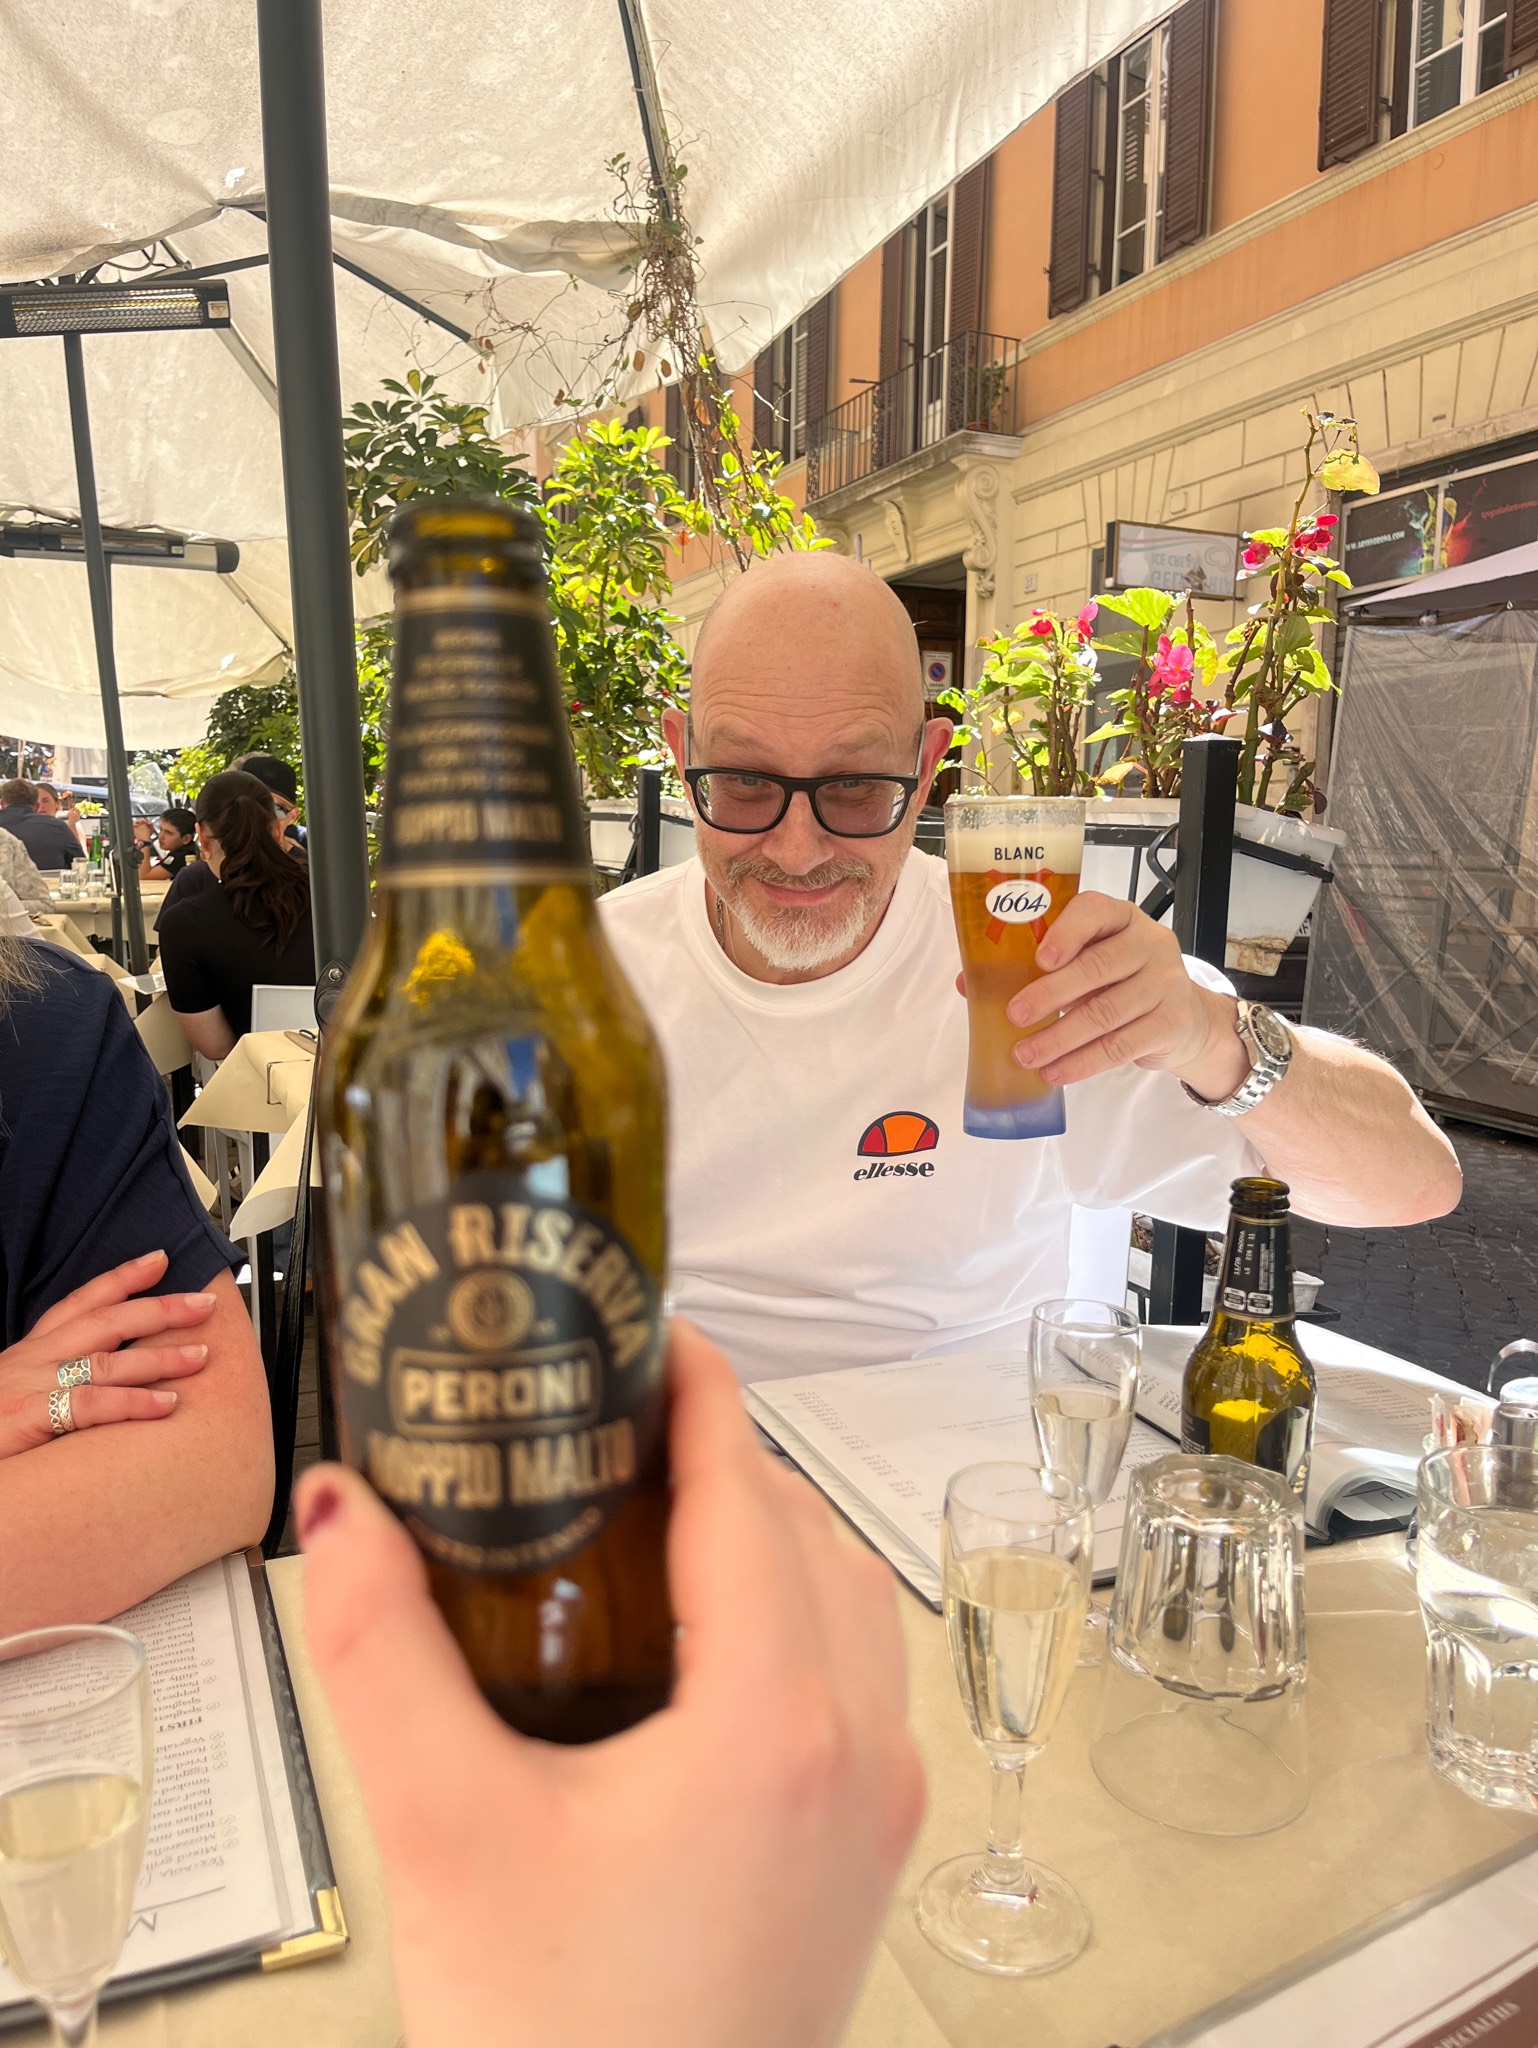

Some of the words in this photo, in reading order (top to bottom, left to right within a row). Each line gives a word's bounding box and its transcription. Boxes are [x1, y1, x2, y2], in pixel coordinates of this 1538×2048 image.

[994, 846, 1045, 860] BLANC
[992, 890, 1047, 913] 1664
[853, 1162, 935, 1181] ellesse
[1237, 1230, 1246, 1253] PADOVA
[343, 1220, 441, 1387] GRAN
[447, 1203, 651, 1368] RISERVA
[401, 1359, 592, 1423] PERONI
[151, 1663, 198, 1677] Strozzap
[166, 1680, 199, 1691] Penne
[156, 1686, 200, 1703] pepper)
[154, 1697, 202, 1712] Spaghett
[154, 1706, 203, 1721] Spaghett
[156, 1716, 203, 1733] FIRST
[156, 1736, 206, 1754] Vegetabl
[157, 1766, 208, 1784] Eggplant
[161, 1776, 210, 1796] Smoked
[184, 1787, 211, 1801] Beef
[153, 1795, 181, 1806] carp
[175, 1798, 212, 1813] Italian
[176, 1809, 214, 1824] Italian
[177, 1820, 215, 1836] Italian
[147, 1831, 216, 1857] Mozzarella
[177, 1844, 217, 1864] Mixed
